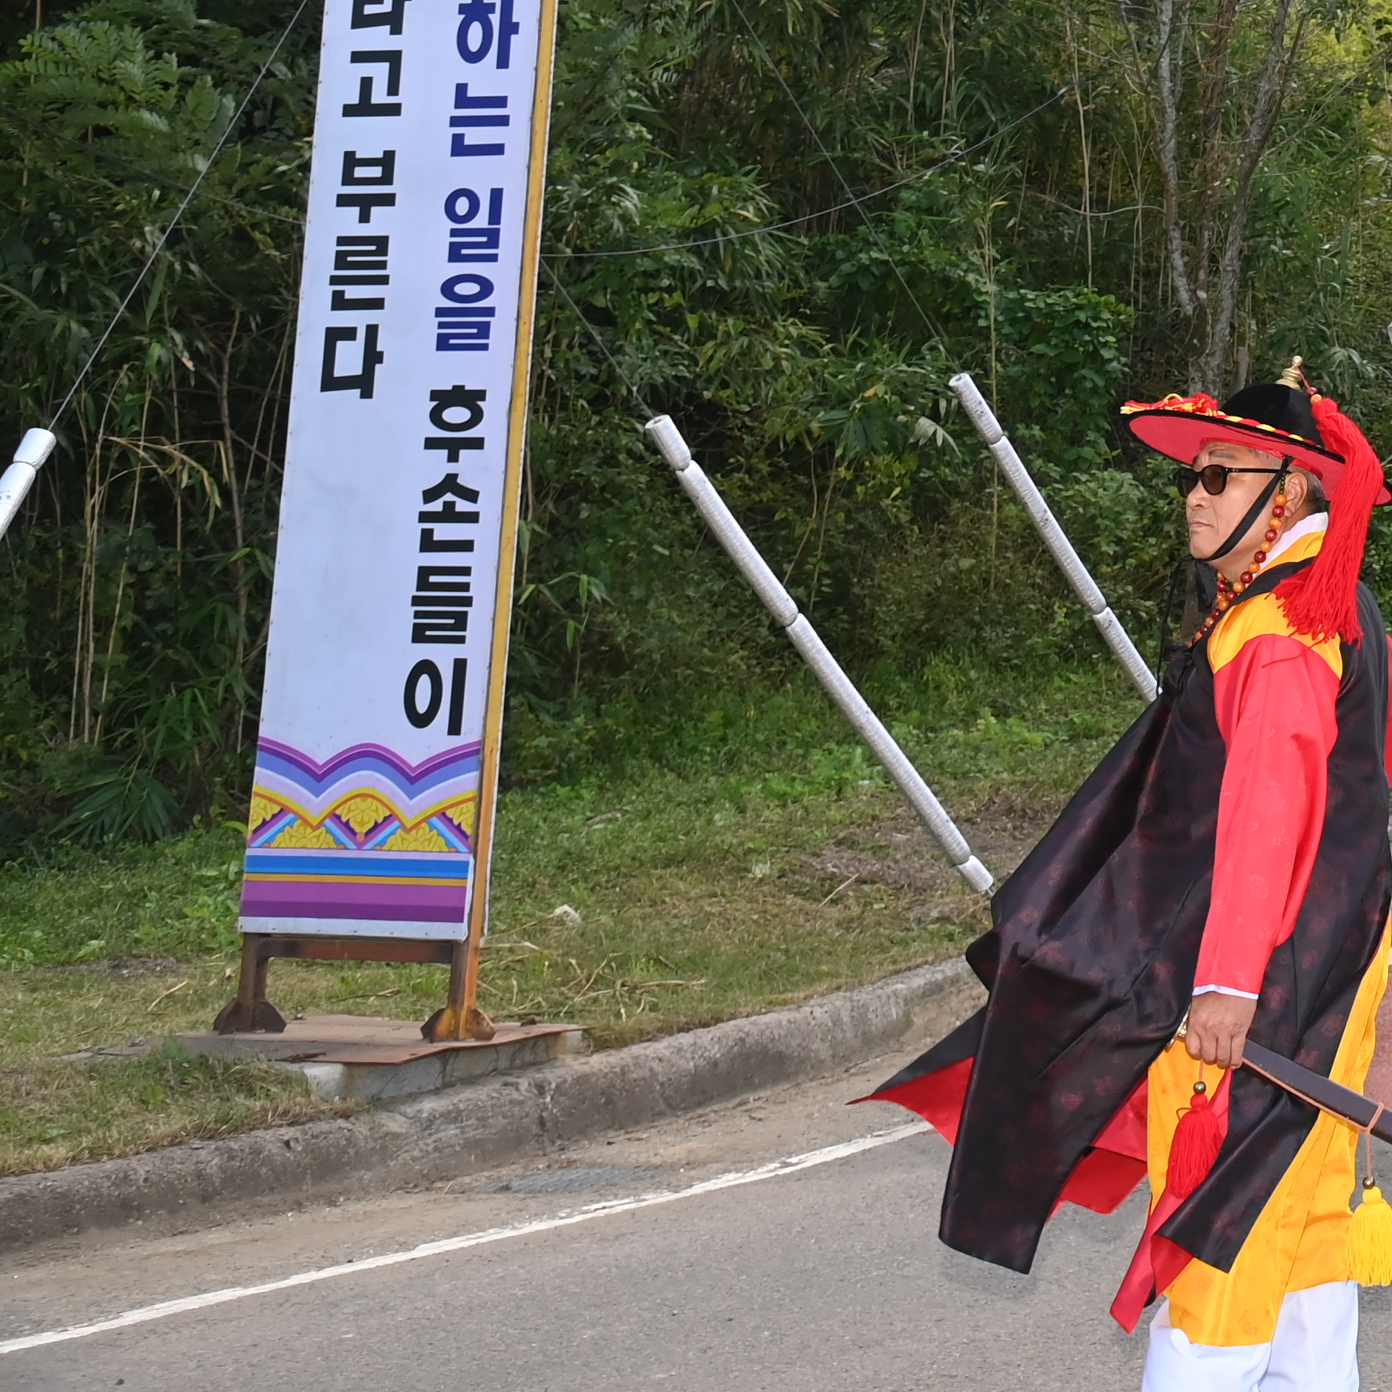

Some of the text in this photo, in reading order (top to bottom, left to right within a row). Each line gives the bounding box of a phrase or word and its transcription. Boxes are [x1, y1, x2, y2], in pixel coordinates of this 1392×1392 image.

[319, 149, 397, 400] 부른다
[433, 187, 504, 353] 일을
[402, 384, 488, 737] 후손들이
